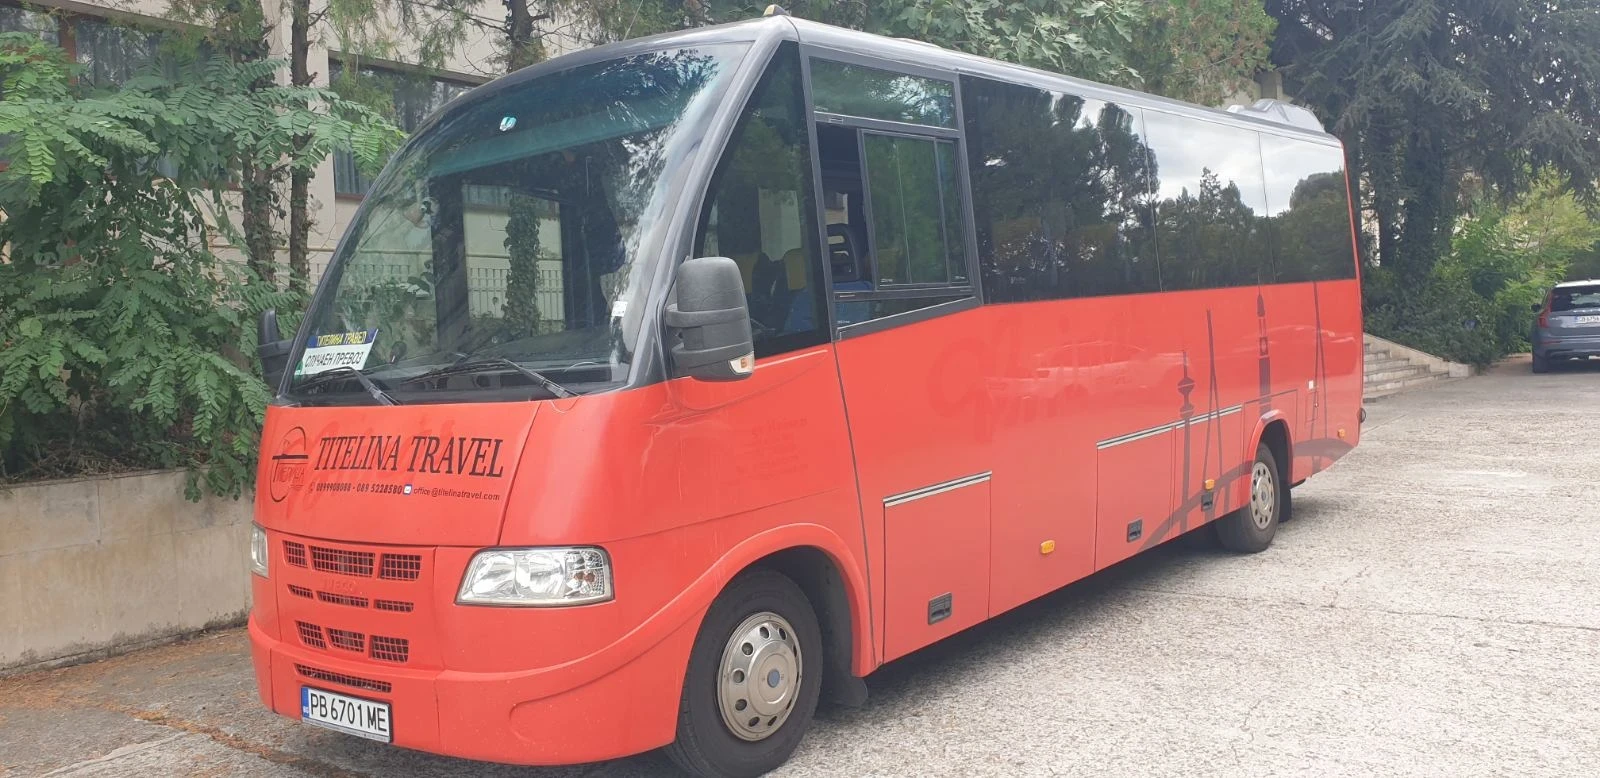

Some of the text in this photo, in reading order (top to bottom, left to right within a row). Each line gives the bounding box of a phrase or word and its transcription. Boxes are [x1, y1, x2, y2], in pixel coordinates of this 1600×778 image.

[305, 352, 364, 367] СЛУЧАЕН ПРЕВОЗ
[314, 435, 504, 478] TITELINA TRAVEL
